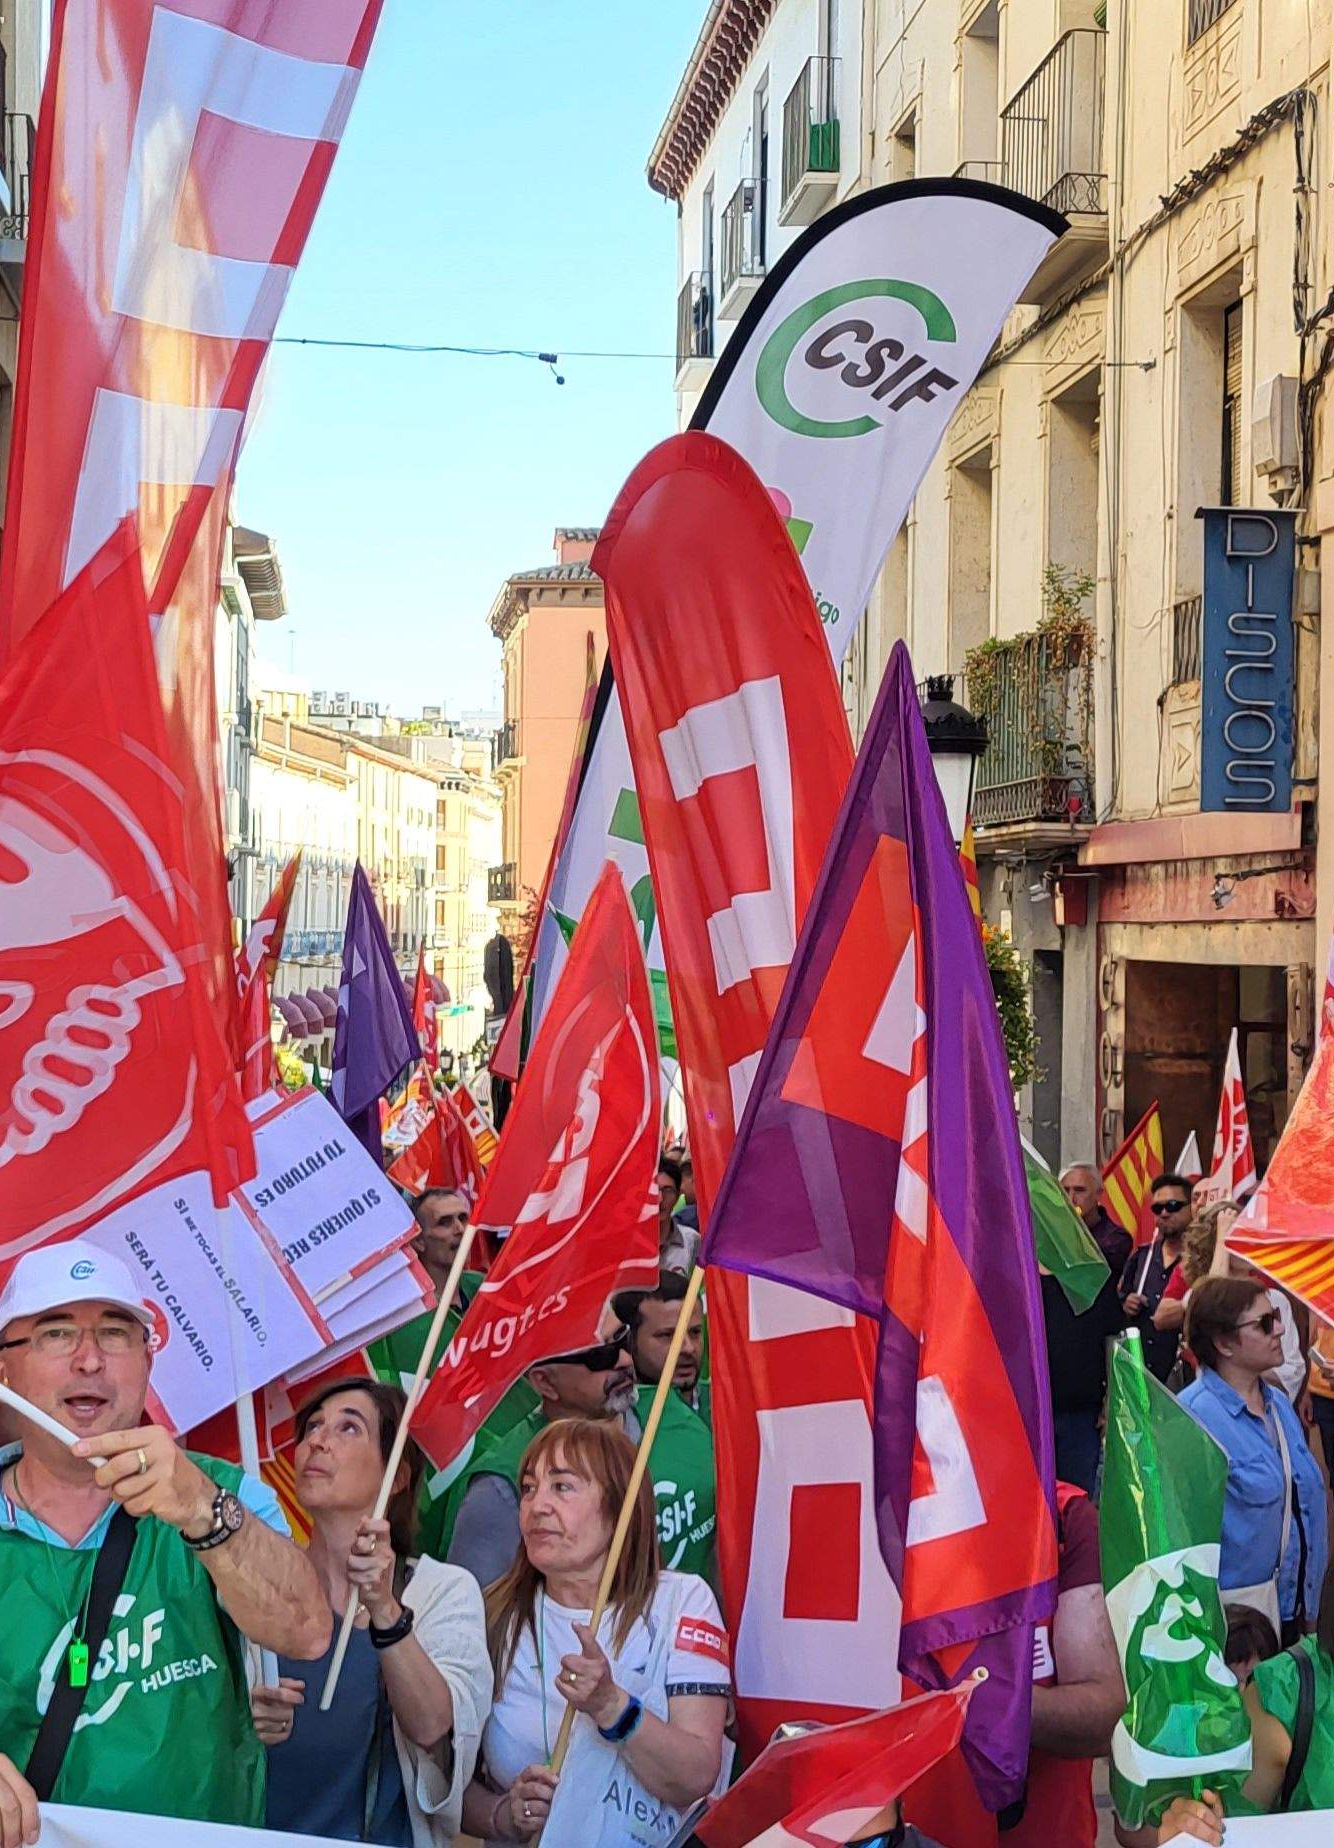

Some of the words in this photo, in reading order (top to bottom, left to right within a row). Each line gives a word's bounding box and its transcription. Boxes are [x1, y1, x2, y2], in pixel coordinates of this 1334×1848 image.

[804, 318, 960, 413] CSIF
[1224, 513, 1279, 804] DISCOS
[323, 1139, 346, 1161] TU
[272, 1151, 326, 1195] FUTURO
[254, 1188, 275, 1207] ES
[362, 1188, 381, 1209] SI
[174, 1198, 189, 1215] SI
[185, 1216, 197, 1232] ME
[195, 1232, 218, 1265] TOCAS
[215, 1265, 225, 1279] EL
[308, 1199, 365, 1246] QUIERES
[280, 1238, 311, 1266] REC
[125, 1231, 156, 1271] SERÁ
[151, 1270, 169, 1292] TU
[165, 1295, 213, 1372] CALVARIO.
[140, 1653, 217, 1694] HUESCA
